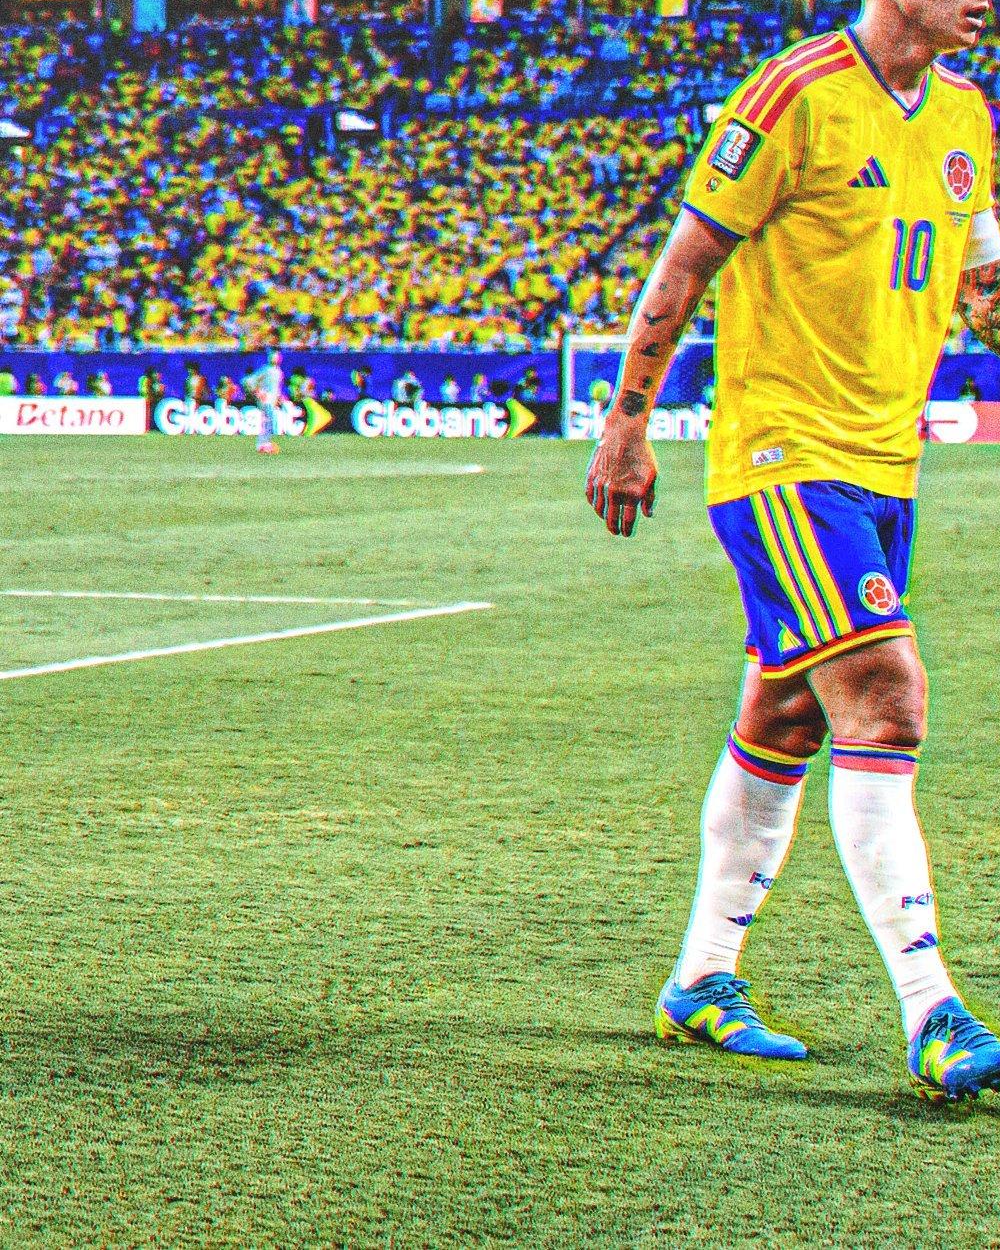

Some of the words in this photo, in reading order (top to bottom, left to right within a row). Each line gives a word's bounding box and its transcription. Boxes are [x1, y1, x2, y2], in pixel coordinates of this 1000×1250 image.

[889, 217, 936, 293] 10
[154, 397, 306, 436] Globat
[351, 398, 511, 437] Globant
